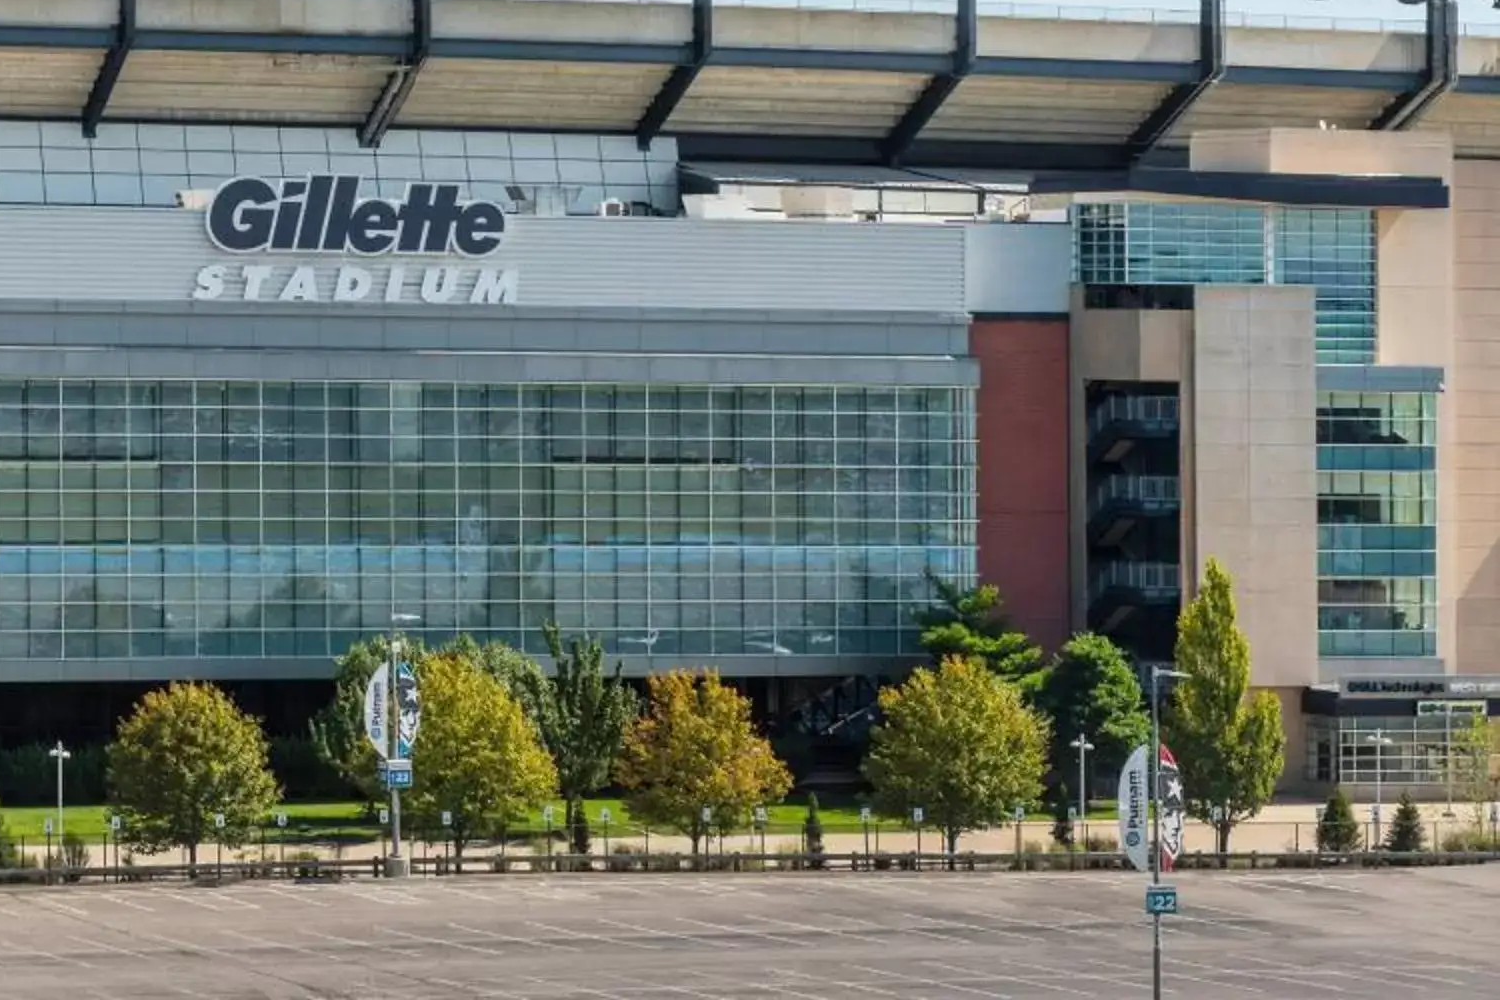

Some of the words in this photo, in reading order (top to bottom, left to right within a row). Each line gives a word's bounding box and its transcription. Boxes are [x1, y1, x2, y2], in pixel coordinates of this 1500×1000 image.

[206, 173, 506, 257] Gillette
[192, 265, 520, 304] STADIUM
[1127, 771, 1140, 829] Putnam
